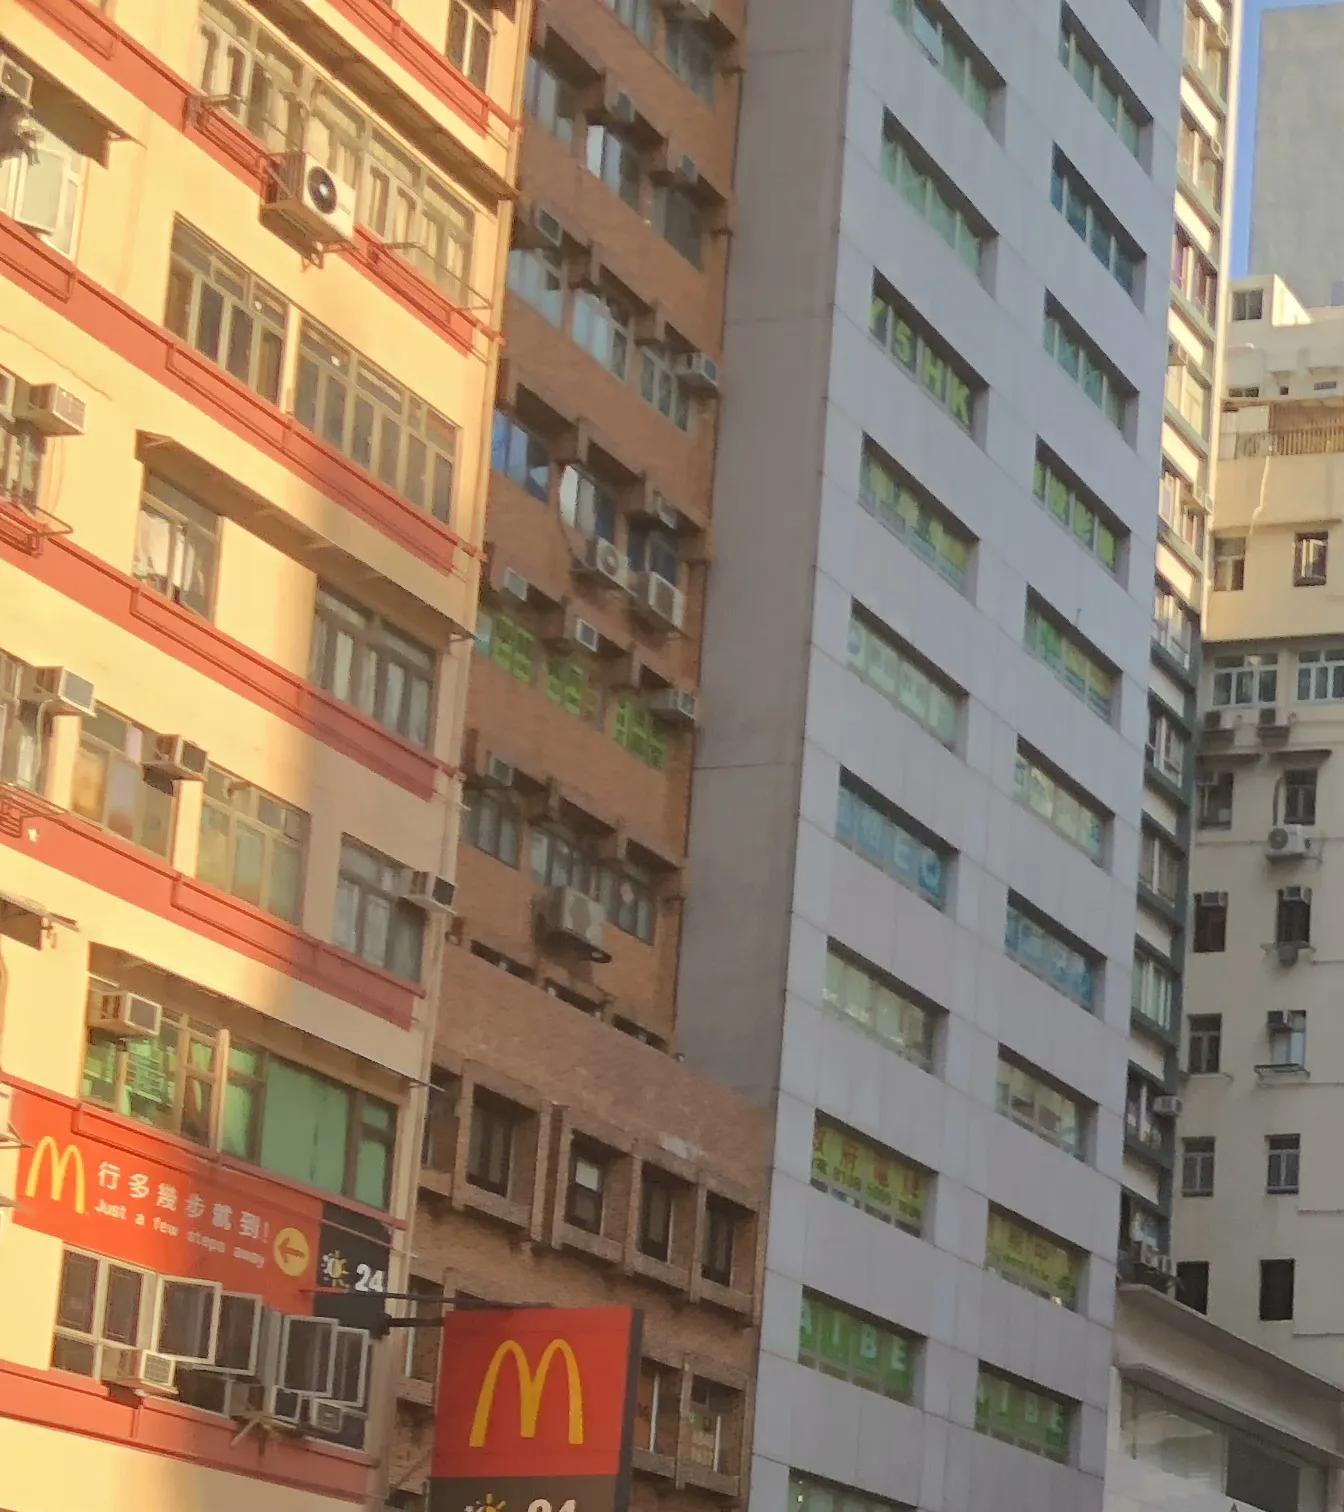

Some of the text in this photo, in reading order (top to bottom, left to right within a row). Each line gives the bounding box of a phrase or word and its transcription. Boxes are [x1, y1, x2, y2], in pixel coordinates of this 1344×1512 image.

[94, 1200, 127, 1222] Just
[135, 1212, 145, 1226] a
[153, 1217, 179, 1238] few
[355, 1262, 385, 1293] 24
